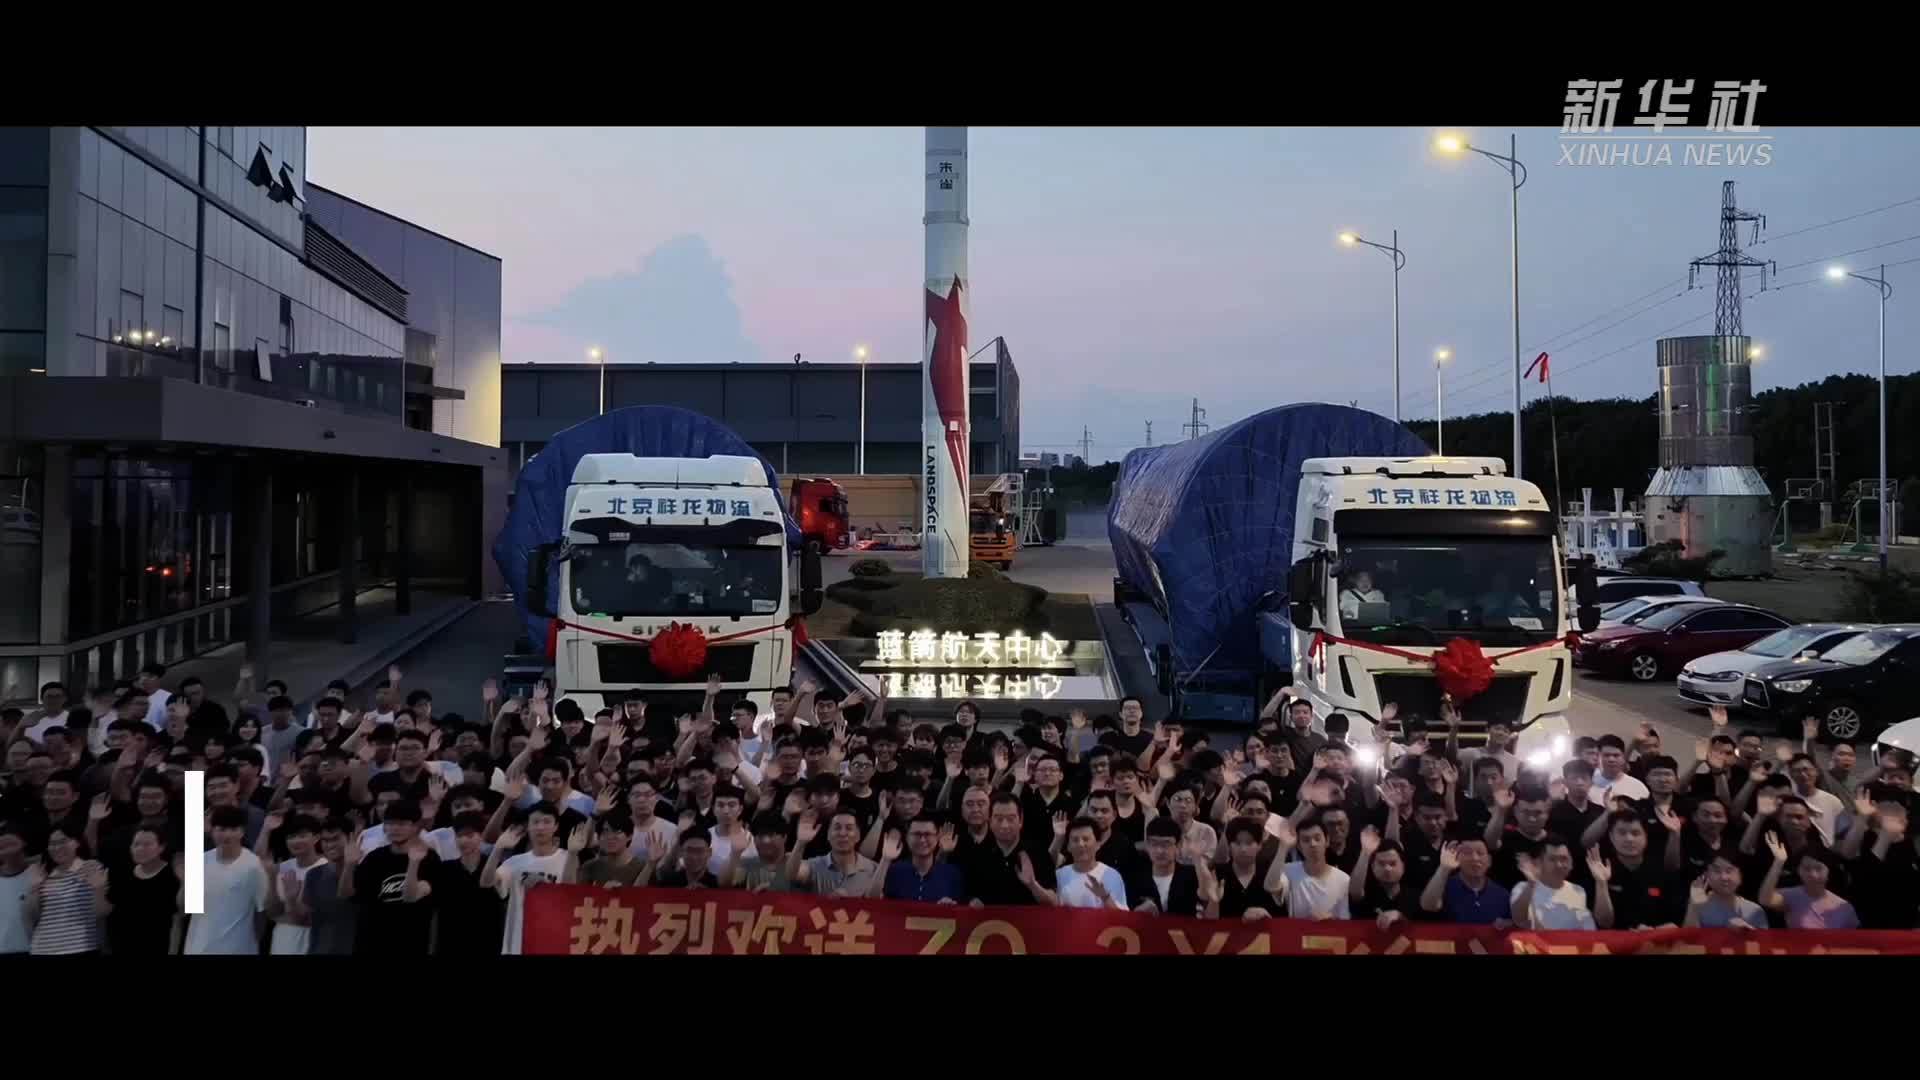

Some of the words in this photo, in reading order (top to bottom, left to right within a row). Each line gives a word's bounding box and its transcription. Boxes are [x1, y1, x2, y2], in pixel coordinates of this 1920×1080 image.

[926, 446, 938, 534] LANDSPACE
[1367, 488, 1517, 506] 北京祥龙物流
[607, 498, 750, 517] 北京祥龙物流
[876, 630, 1063, 664] 蓝箭航天中心
